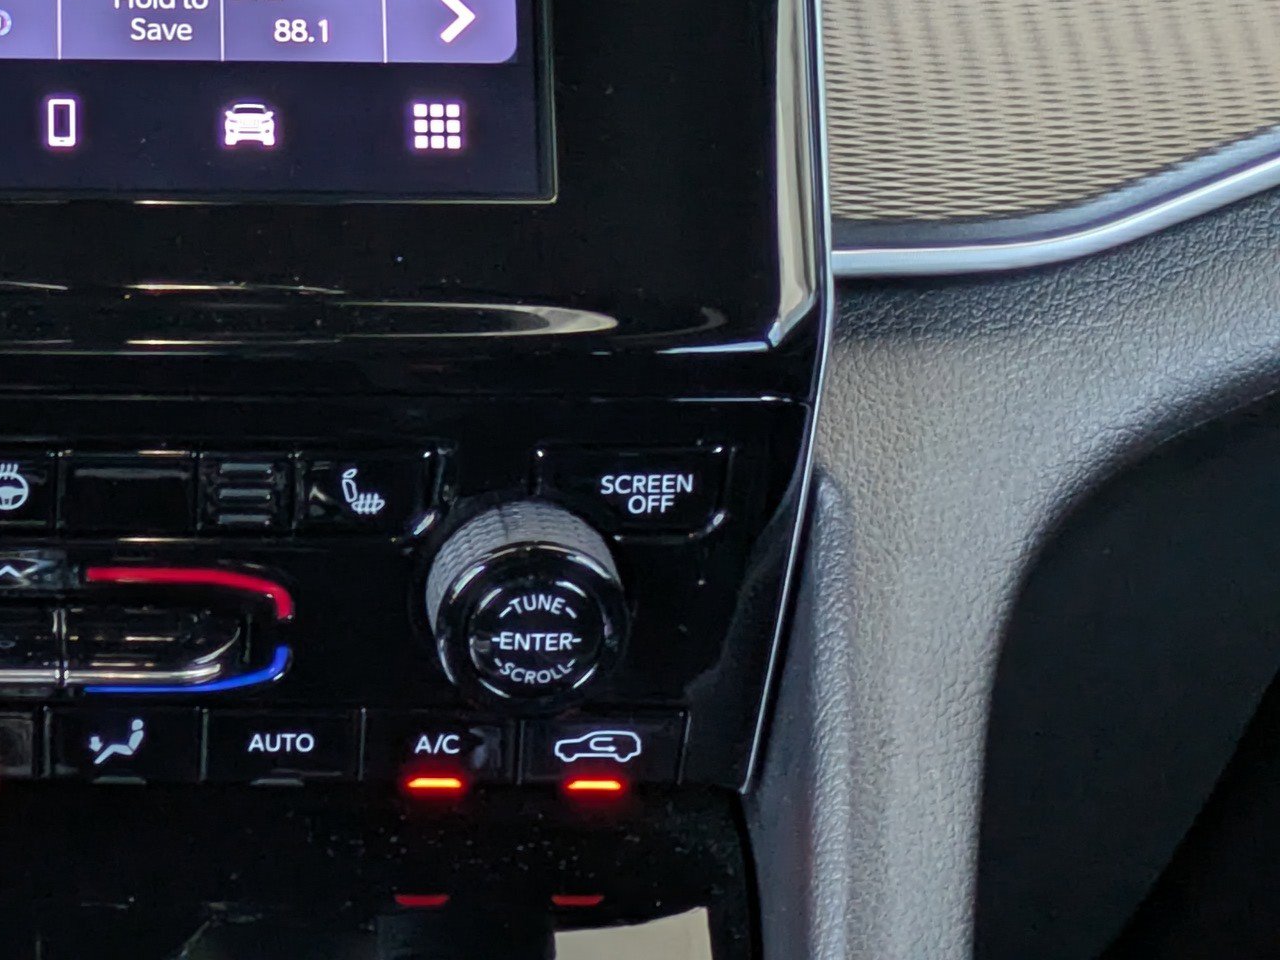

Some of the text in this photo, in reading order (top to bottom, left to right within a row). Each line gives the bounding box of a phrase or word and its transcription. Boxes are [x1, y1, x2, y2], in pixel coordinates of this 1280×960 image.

[130, 17, 193, 41] Save
[274, 19, 329, 44] 88.1
[600, 473, 694, 496] SCREEN
[627, 494, 676, 515] OFF
[248, 733, 315, 754] AUTO
[414, 733, 461, 755] A/C
